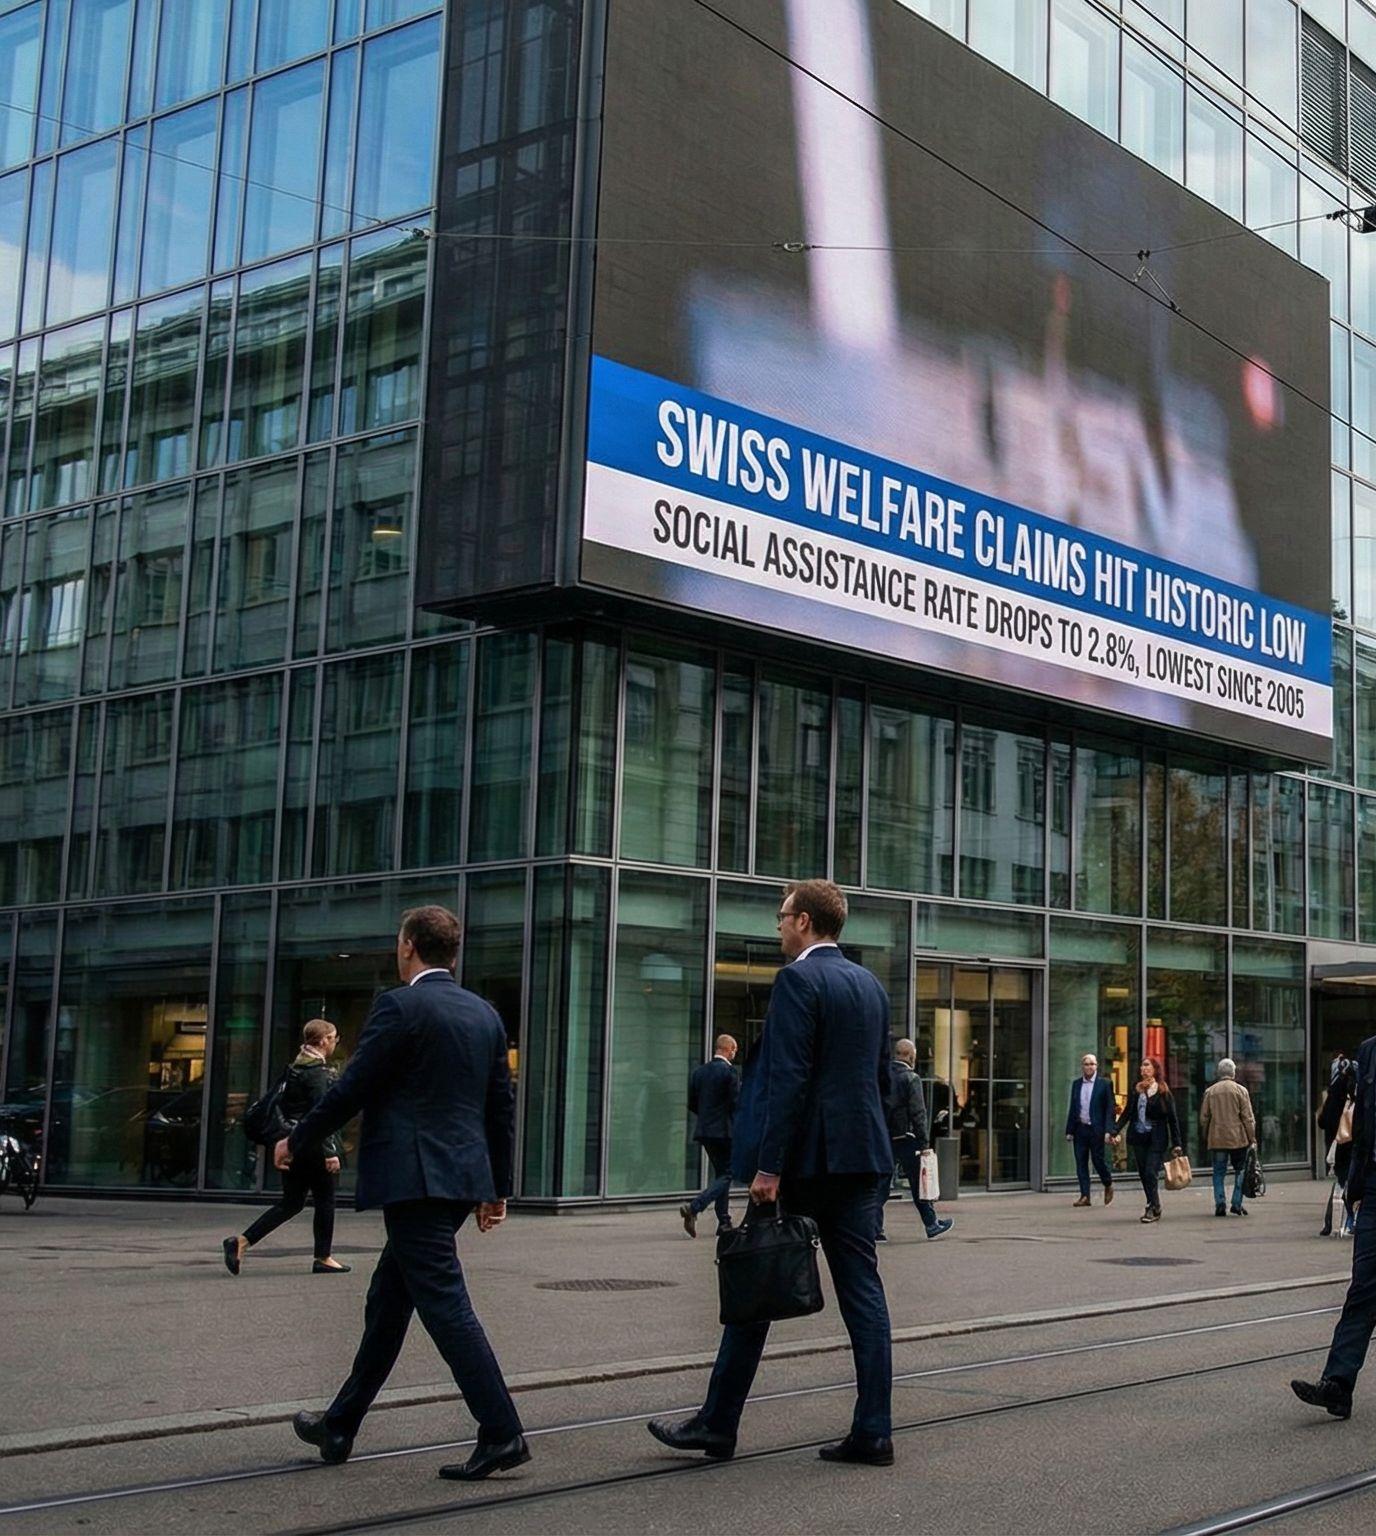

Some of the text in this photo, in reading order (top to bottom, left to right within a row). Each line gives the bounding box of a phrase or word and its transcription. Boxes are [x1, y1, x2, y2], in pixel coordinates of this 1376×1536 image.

[653, 499, 1305, 719] SOCIAL ASSISTANCE RATE DROPS TO 2.8%, LOWEST SINCE 2005
[656, 400, 1306, 665] SWISS WELFARE CLAIMS HIT HISTORIC LOW
